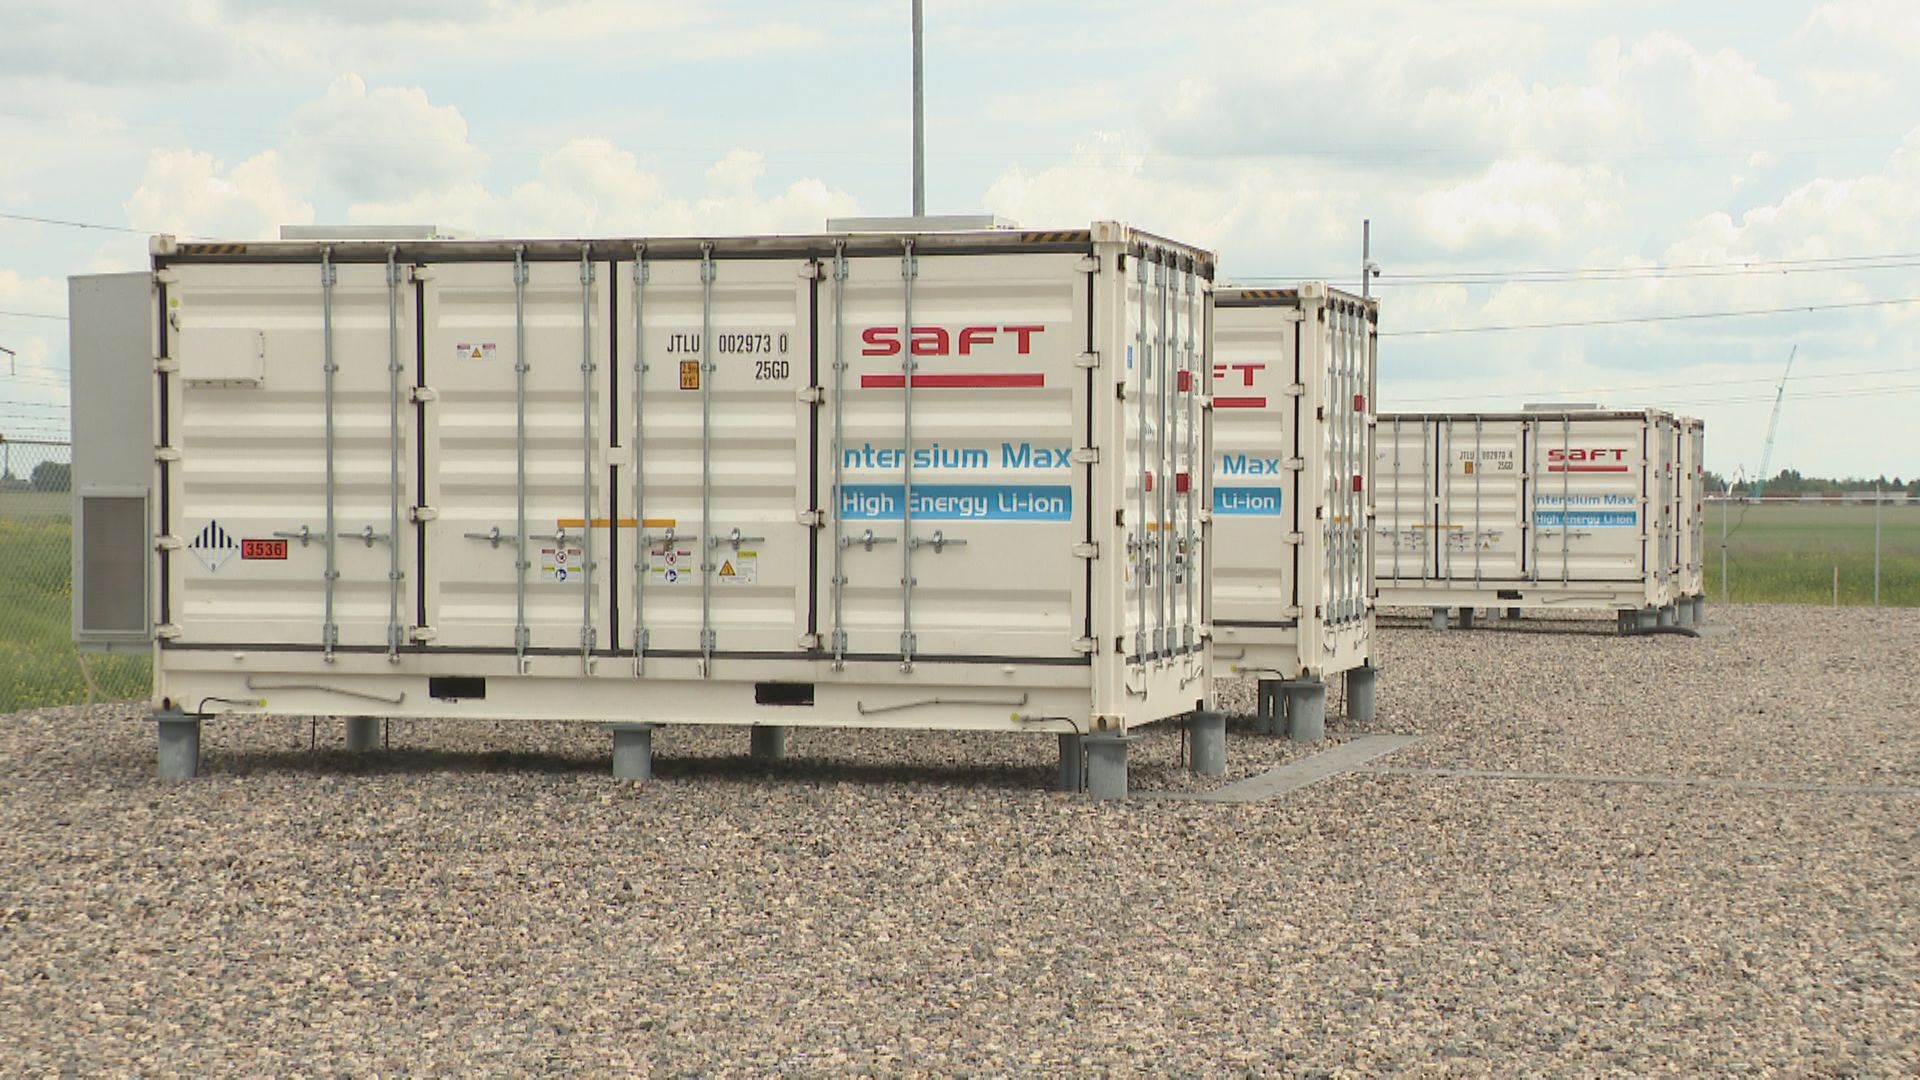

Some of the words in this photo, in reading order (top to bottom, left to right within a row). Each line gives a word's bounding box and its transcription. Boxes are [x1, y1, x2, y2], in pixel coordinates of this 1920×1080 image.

[667, 334, 699, 353] JTLU
[719, 334, 771, 353] 002973
[779, 334, 788, 353] 0
[755, 361, 789, 380] 25GD
[835, 443, 989, 468] ntensium
[1001, 443, 1072, 468] Max
[1223, 454, 1279, 474] Max
[842, 492, 894, 516] High
[909, 492, 988, 516] Energy
[998, 492, 1065, 514] Li-ion
[1222, 493, 1275, 509] Li-ion
[1533, 494, 1600, 504] ntensium
[1604, 494, 1634, 504] Max
[1536, 514, 1560, 525] High
[247, 543, 282, 556] 3536
